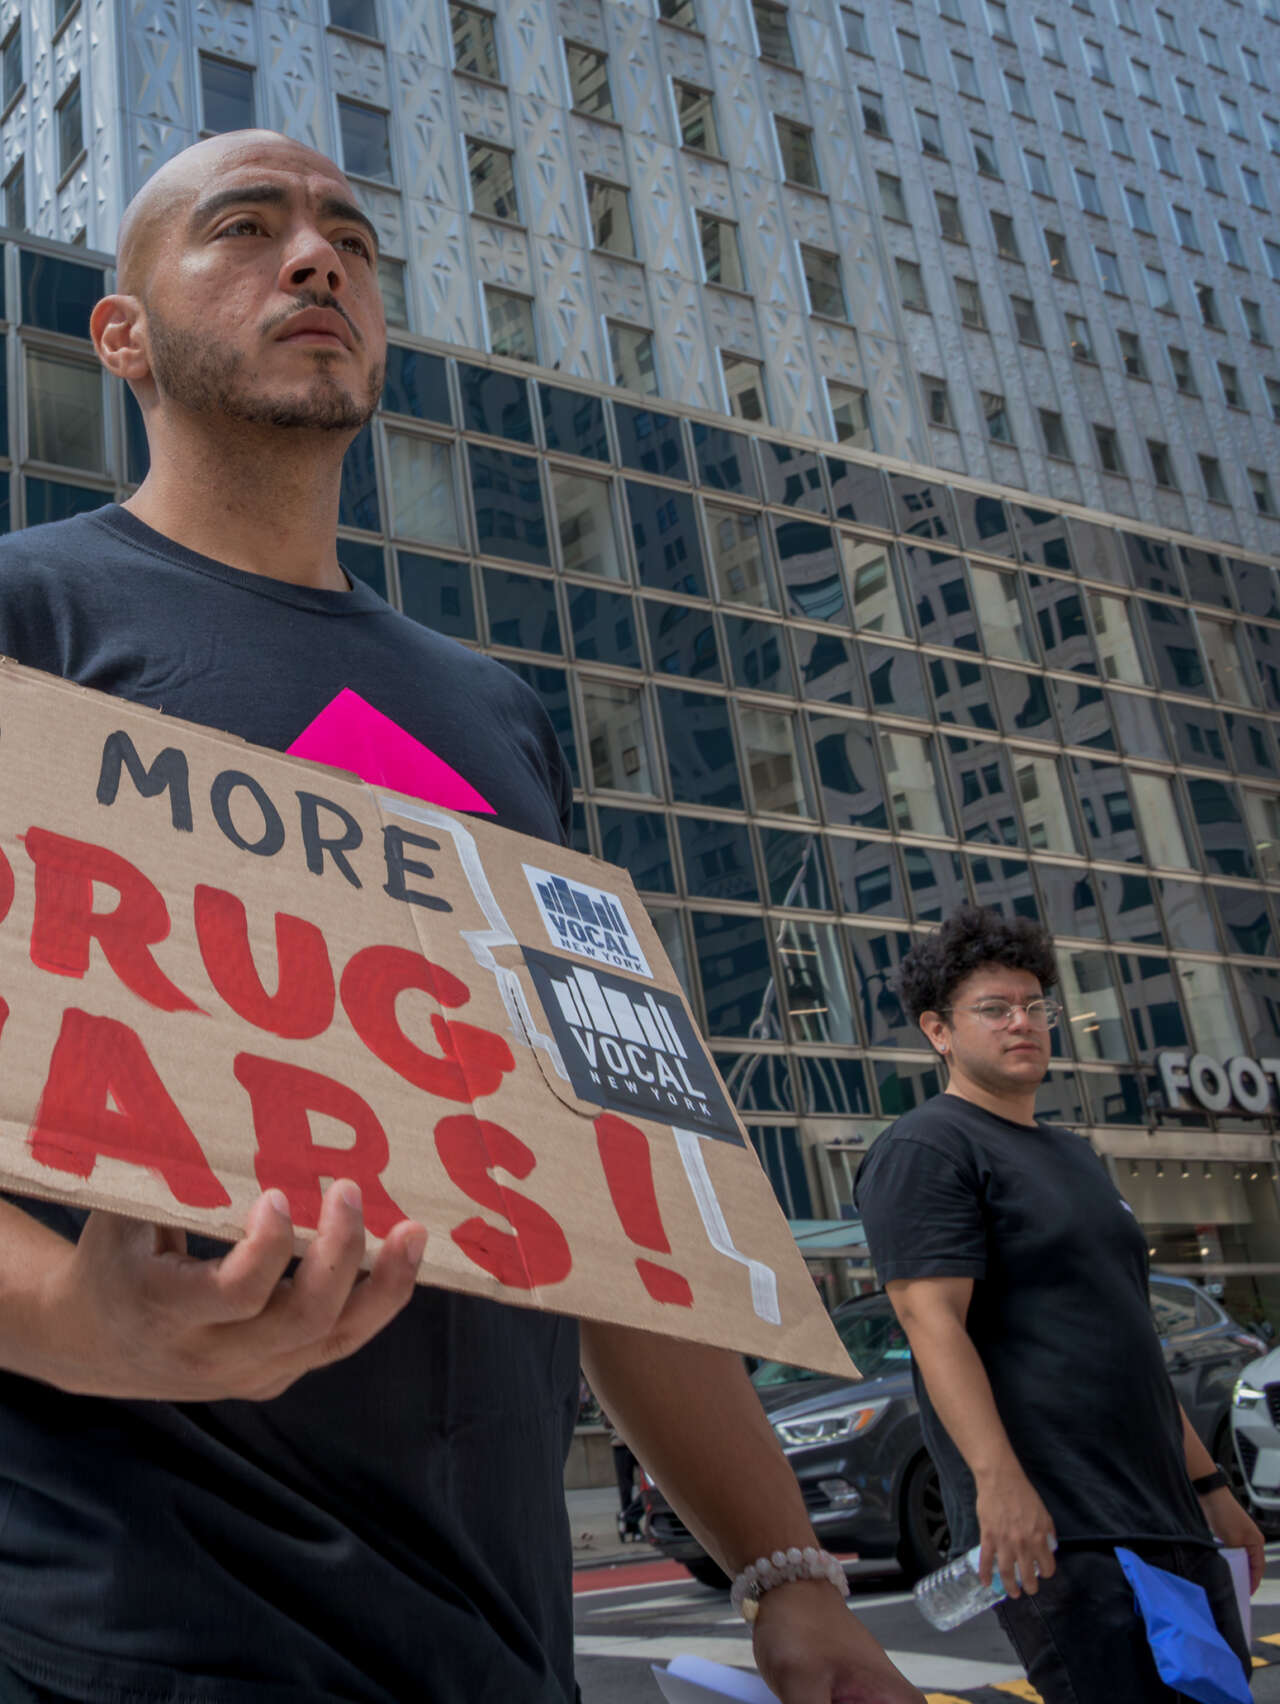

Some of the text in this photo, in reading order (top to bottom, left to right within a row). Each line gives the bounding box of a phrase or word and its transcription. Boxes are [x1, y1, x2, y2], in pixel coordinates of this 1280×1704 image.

[96, 730, 453, 914] MORE
[548, 913, 639, 960] VOCAL
[560, 938, 644, 973] NEW YORK
[570, 1026, 706, 1100] VOCAL
[589, 1070, 712, 1117] NEW YORK
